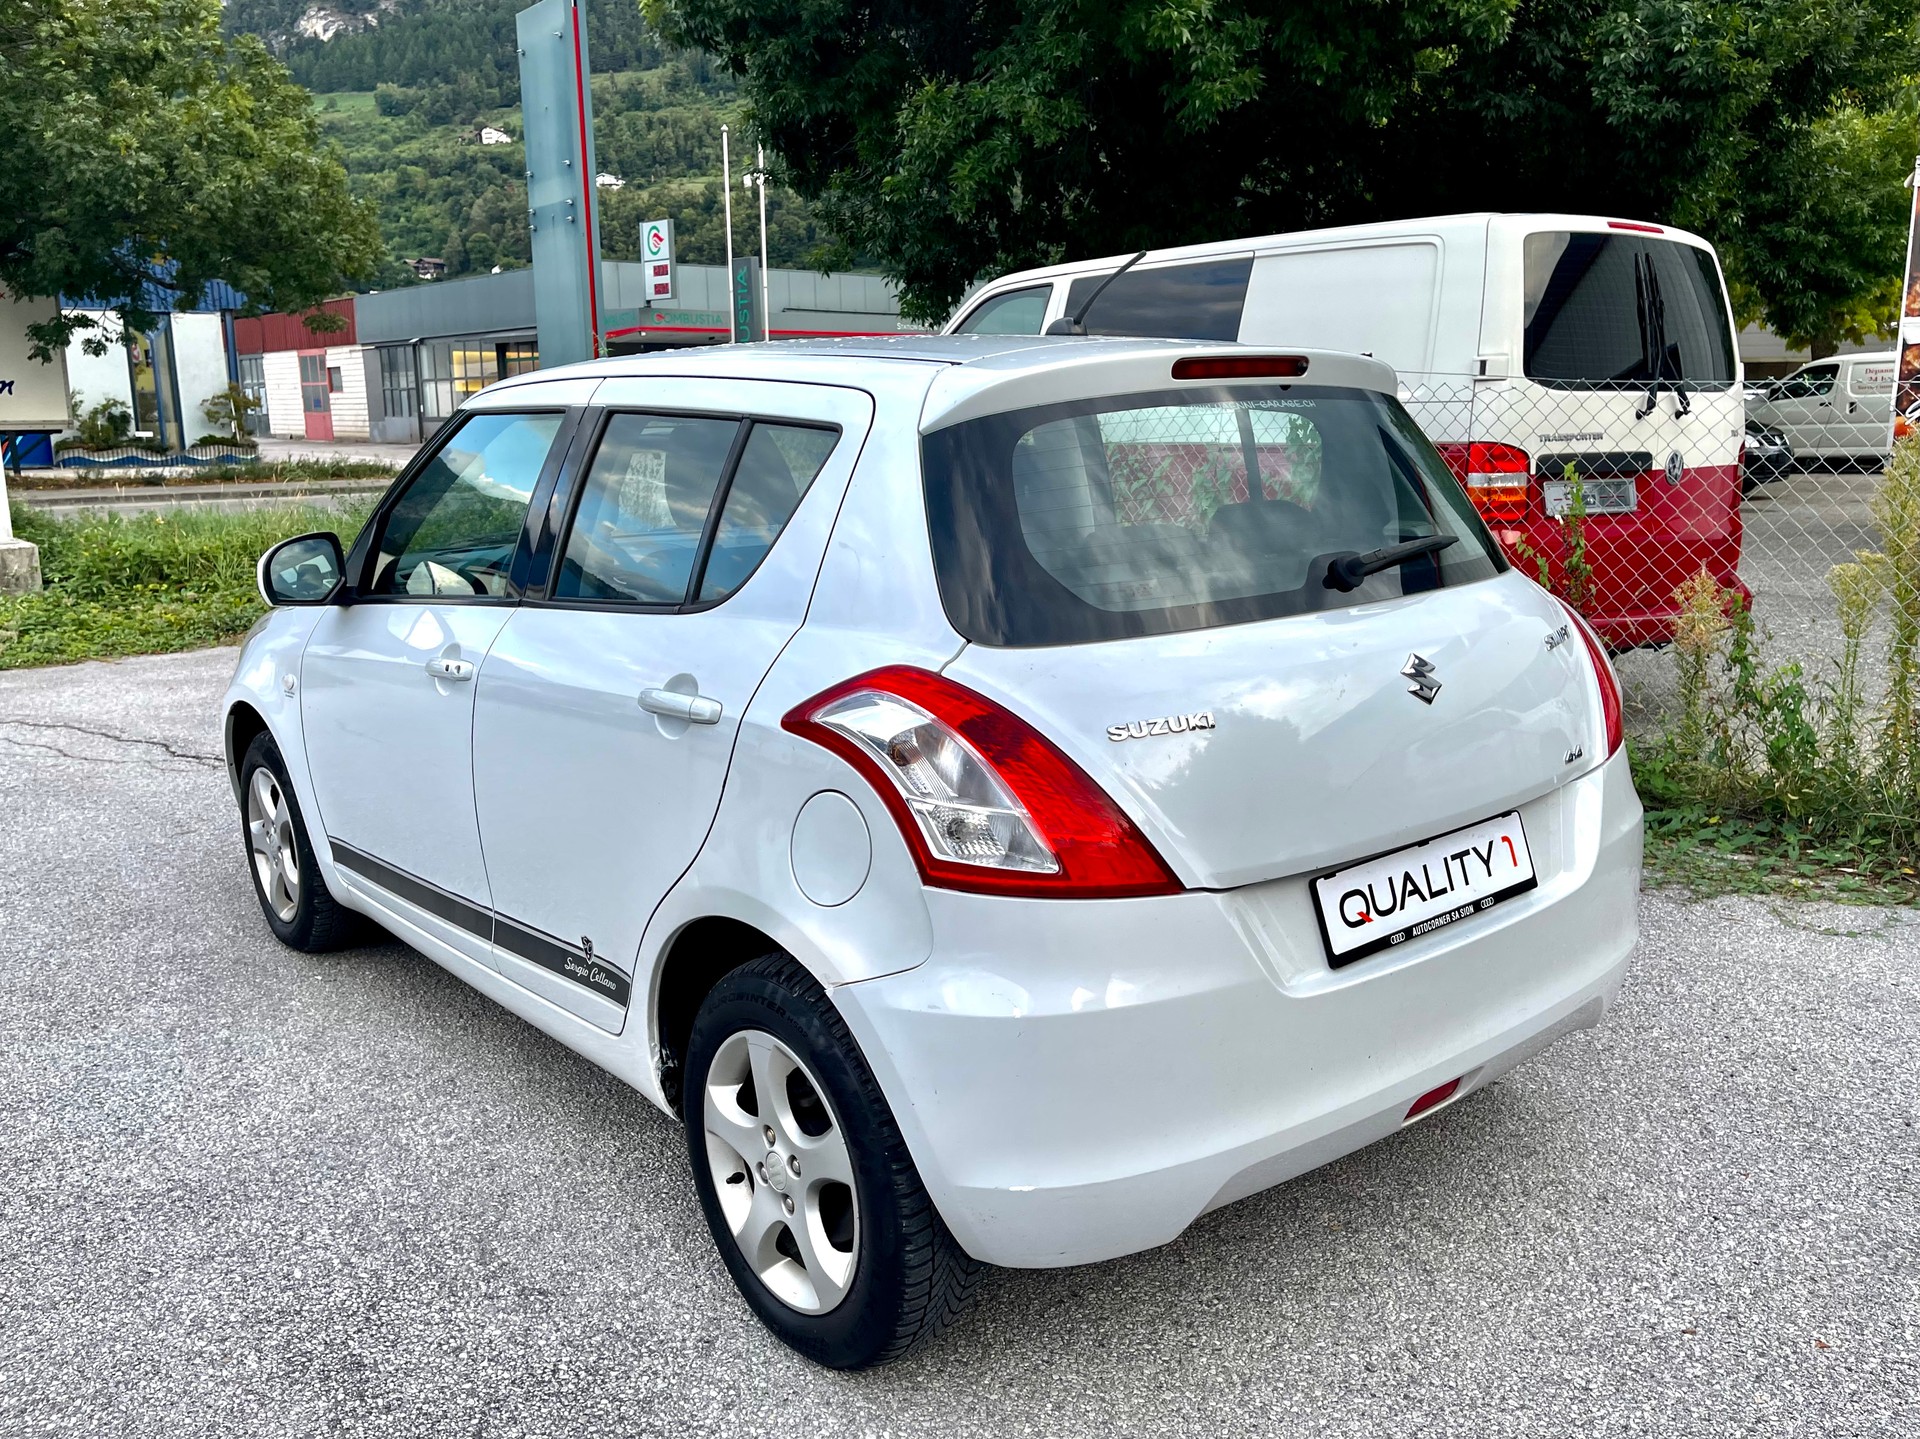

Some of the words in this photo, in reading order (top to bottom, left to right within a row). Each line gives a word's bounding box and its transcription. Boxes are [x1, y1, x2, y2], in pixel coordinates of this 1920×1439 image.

[1539, 432, 1604, 443] TRANSPORTER
[1106, 711, 1216, 742] SUZUKI
[1338, 840, 1494, 928] QUALITY
[1501, 835, 1518, 868] 1
[1412, 913, 1451, 937] AUTOCORNER
[1451, 911, 1460, 921] SA
[1460, 905, 1474, 919] SION
[564, 957, 589, 977] Sergio
[589, 967, 617, 991] Cellano
